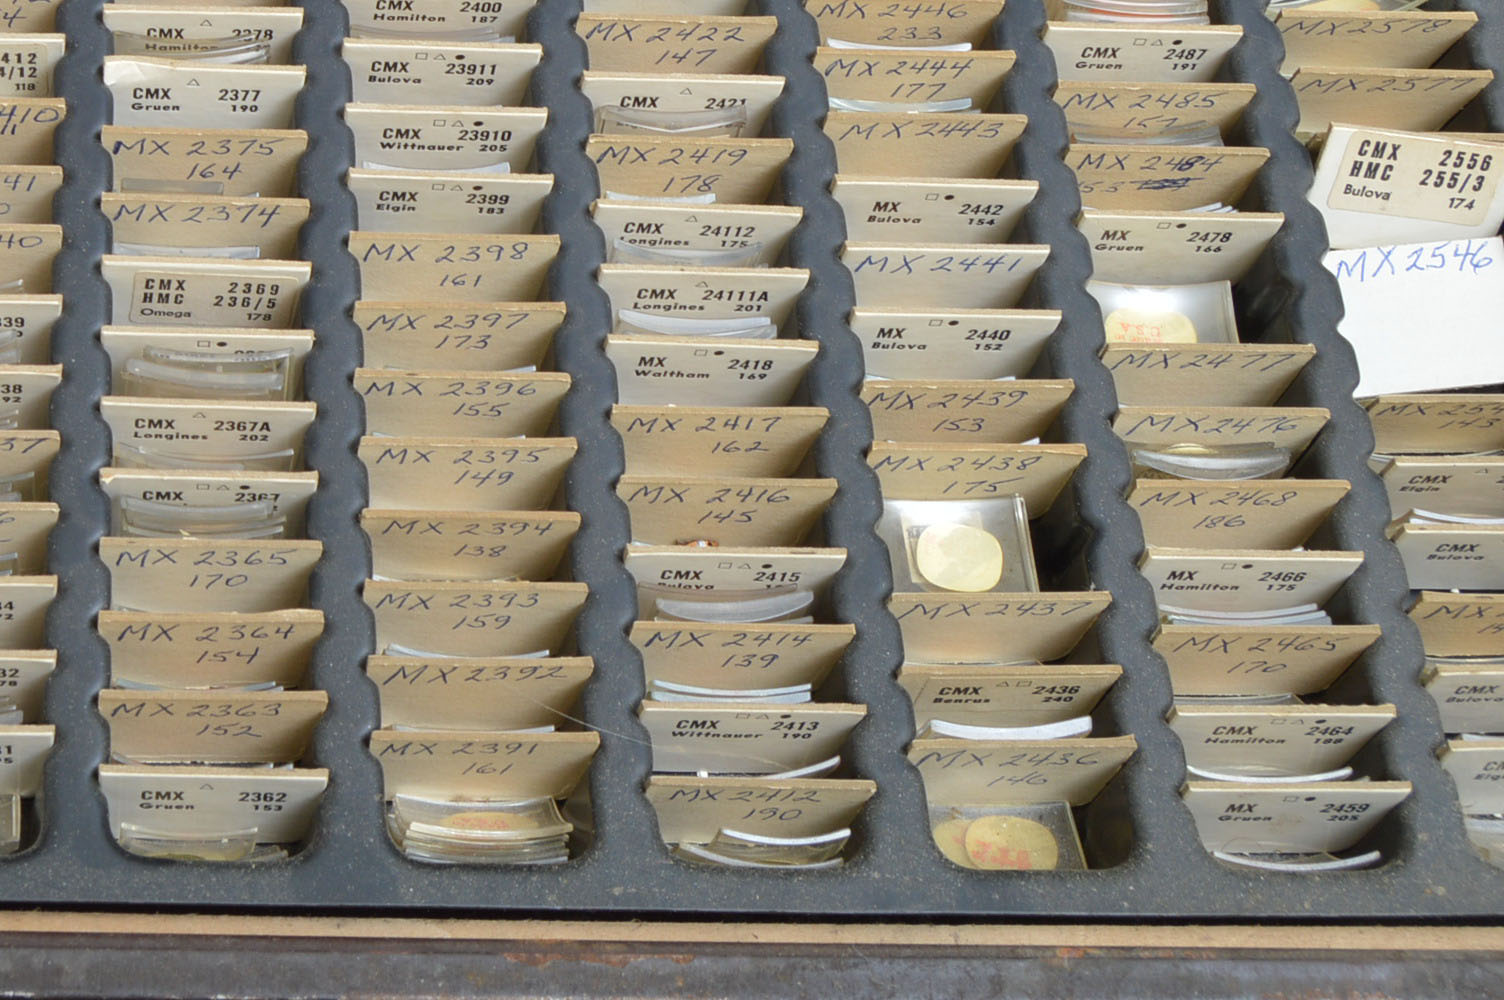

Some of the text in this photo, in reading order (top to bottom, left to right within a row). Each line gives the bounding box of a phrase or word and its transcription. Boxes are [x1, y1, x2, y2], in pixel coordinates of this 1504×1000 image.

[1080, 46, 1208, 61] CMX 2487
[1075, 60, 1198, 71] Gruen 191
[15, 82, 36, 90] 118
[132, 87, 261, 102] CMX 2377
[130, 102, 259, 113] Gruen 190
[382, 127, 513, 142] CMX 23910
[379, 141, 508, 153] Wittnauer 205
[1357, 139, 1493, 172] CMX 2556
[1348, 160, 1486, 194] HMC 255/3
[1342, 183, 1476, 211] Bulova 174
[1336, 236, 1494, 286] MX 2546
[144, 278, 280, 296] CMX 2369
[141, 291, 278, 311] HMC 236/5
[139, 307, 271, 321] Omega 178
[876, 327, 1012, 341] MX 2440
[871, 341, 1004, 351] Bulova 152
[637, 356, 774, 371] MX 2418
[634, 369, 768, 380] Waltham 169
[1139, 491, 1202, 507] MX
[1192, 514, 1246, 529] 186
[1166, 570, 1308, 583] MX 2466
[1159, 583, 1297, 592] Hamilton 175
[374, 591, 540, 611] MX 2393
[451, 613, 512, 630] 159
[140, 790, 288, 803] CMX 2362
